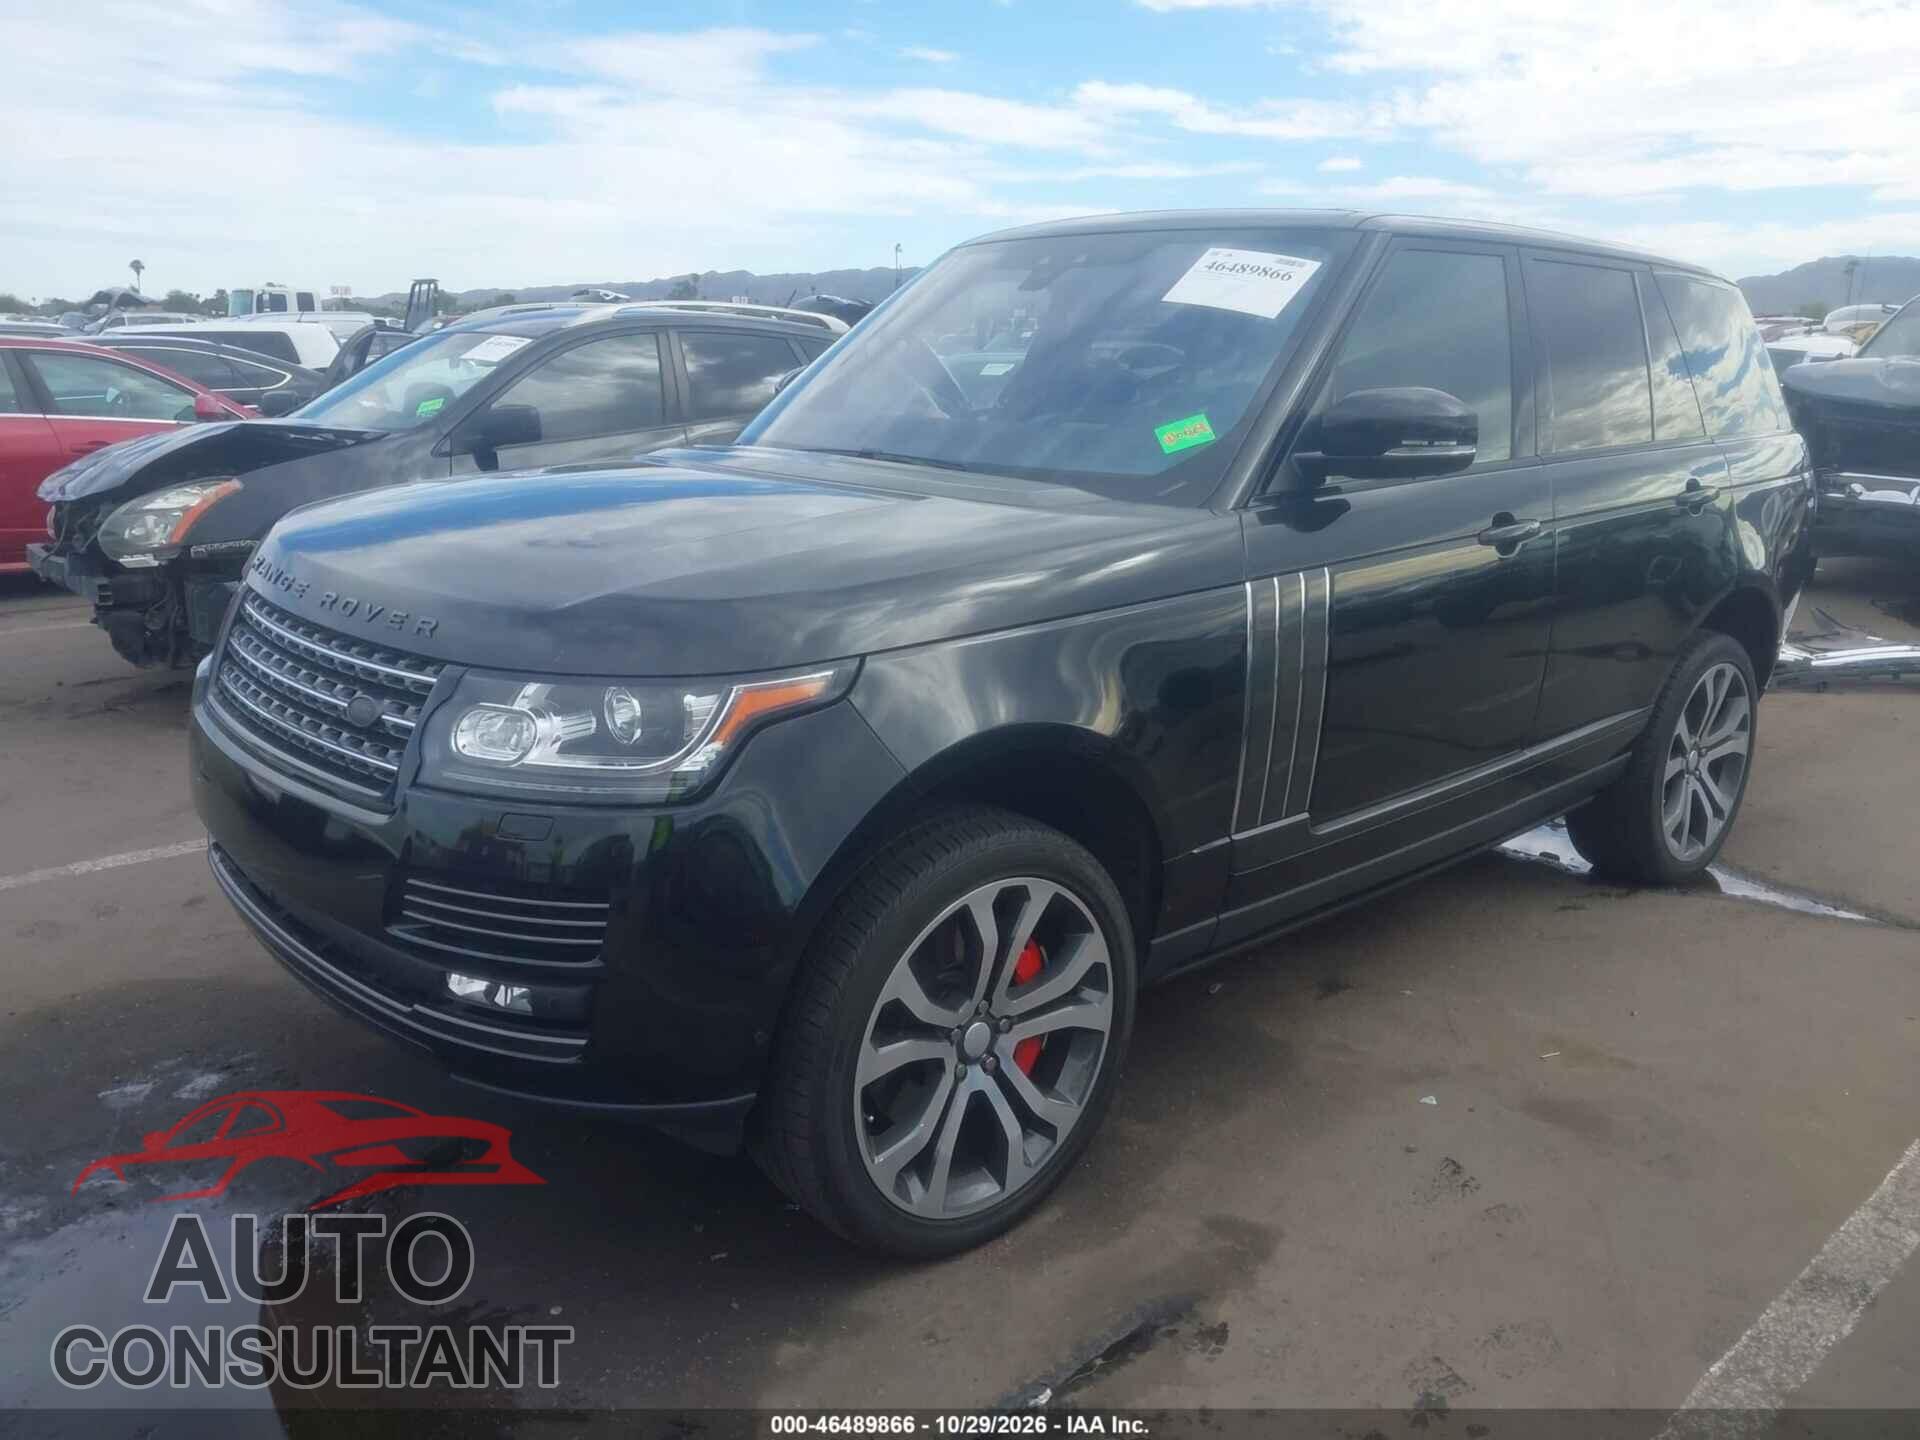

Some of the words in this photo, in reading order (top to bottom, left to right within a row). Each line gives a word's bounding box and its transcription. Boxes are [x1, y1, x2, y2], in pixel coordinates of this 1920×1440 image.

[1205, 260, 1295, 282] 46489866
[250, 556, 311, 599] RANGE
[320, 591, 439, 639] ROVER
